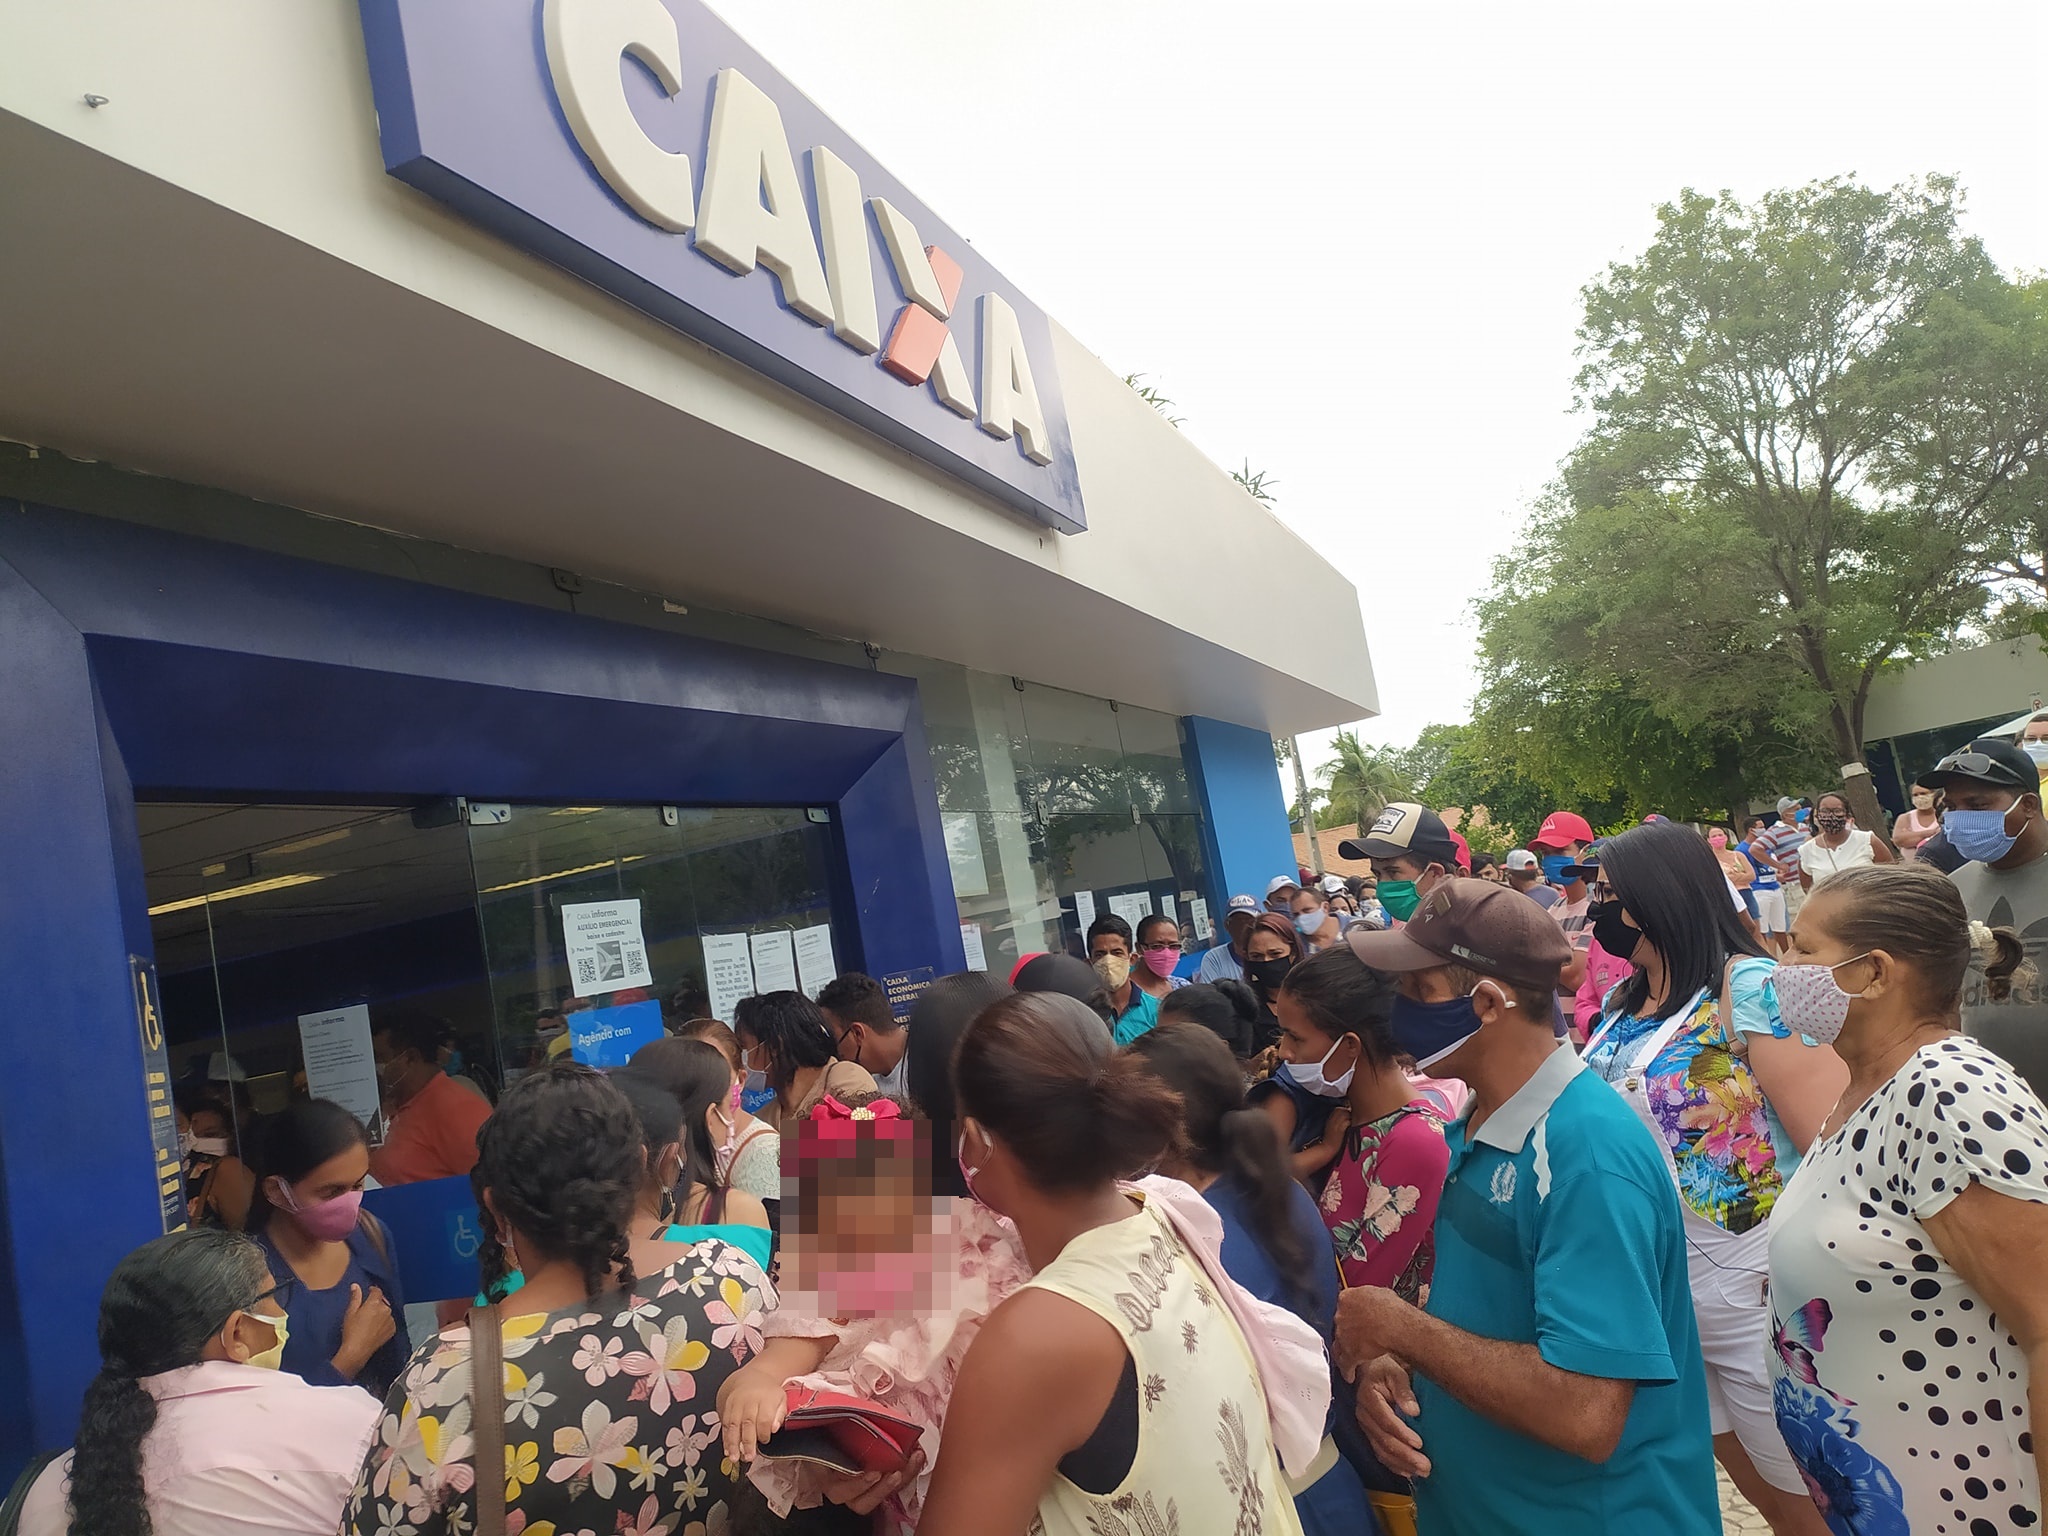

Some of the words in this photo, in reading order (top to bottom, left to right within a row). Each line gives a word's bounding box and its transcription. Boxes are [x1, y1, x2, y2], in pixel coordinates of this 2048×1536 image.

[543, 0, 1053, 467] CAIXA
[591, 908, 618, 919] informa
[599, 919, 632, 929] EMERGENCIAL
[886, 976, 909, 987] CAIXA
[578, 1028, 613, 1047] Agência
[614, 1026, 632, 1037] com
[749, 1087, 777, 1108] Agênci
